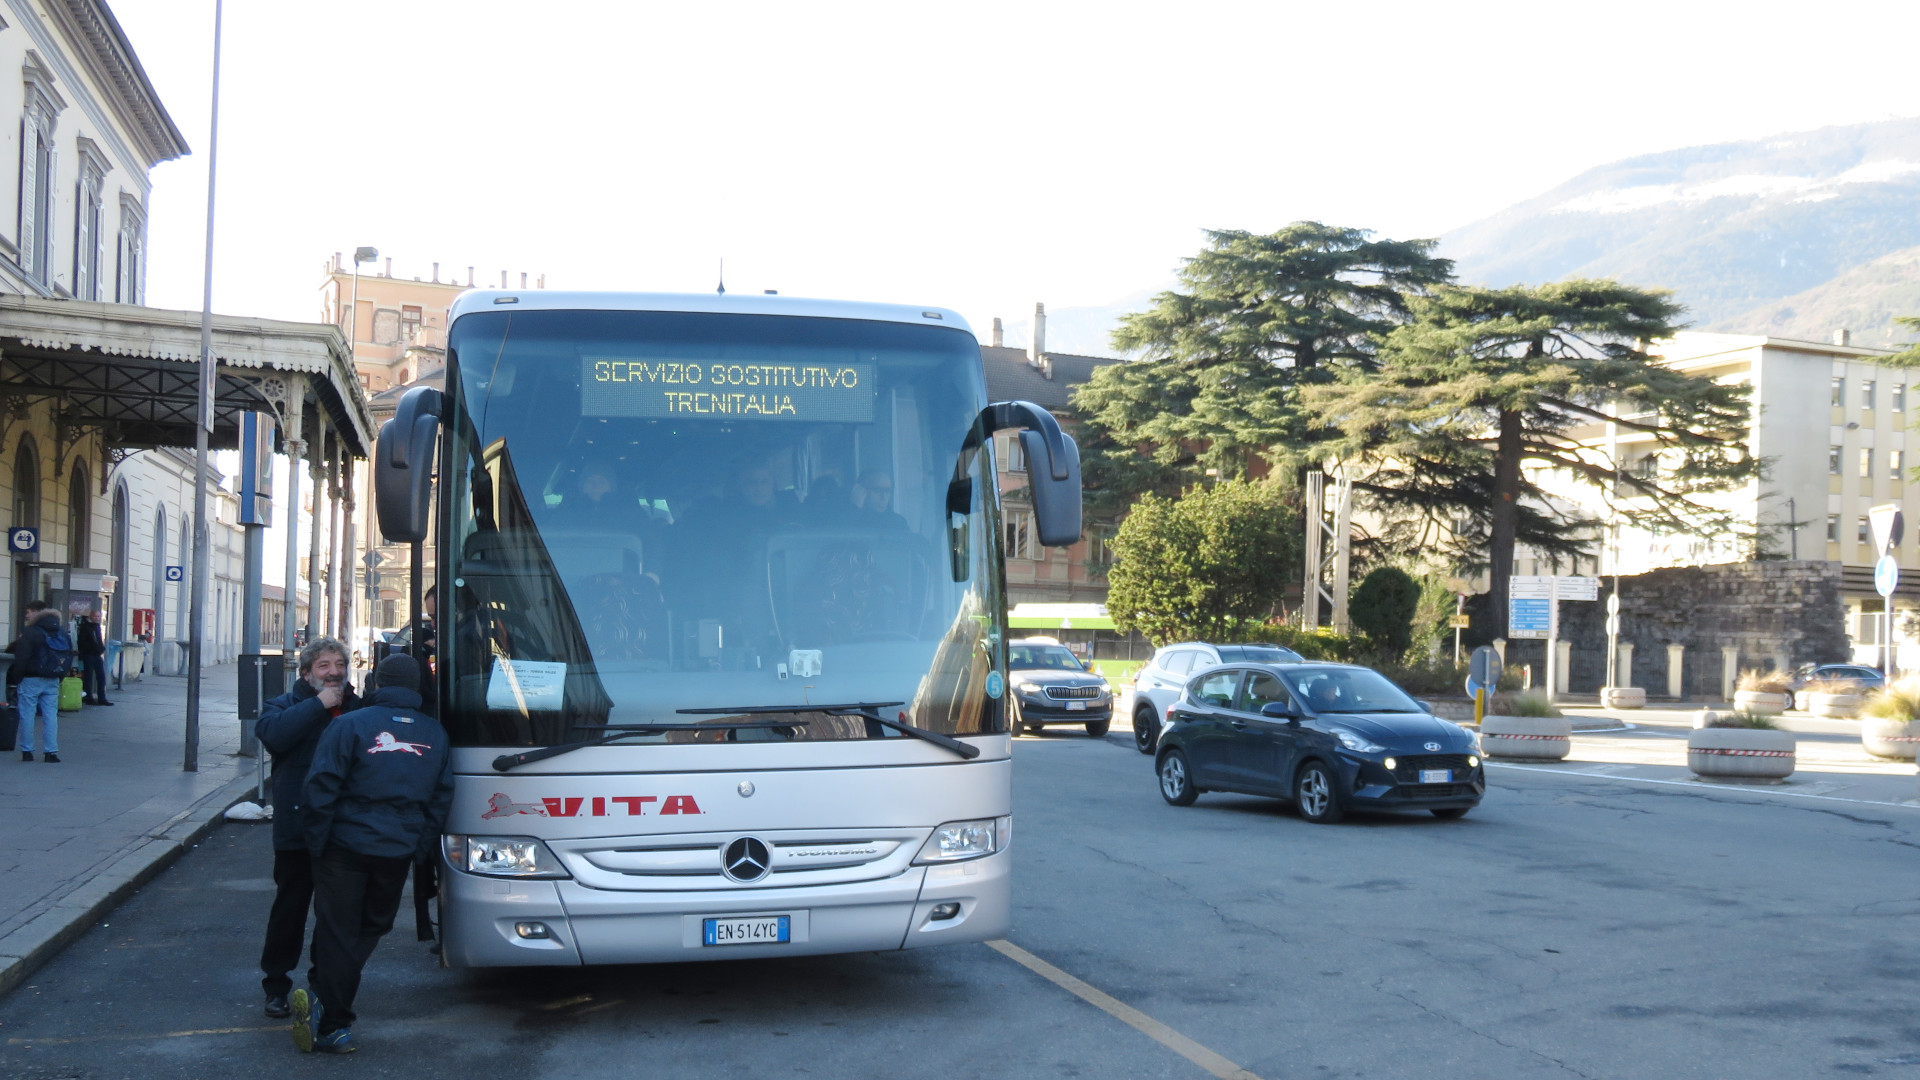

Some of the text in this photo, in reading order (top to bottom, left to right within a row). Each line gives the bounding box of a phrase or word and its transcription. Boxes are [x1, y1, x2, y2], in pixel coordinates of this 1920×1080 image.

[595, 361, 858, 388] SERVIZIO SOSTITUTIVO
[664, 392, 796, 415] TRENITALIA
[991, 680, 1000, 695] 5
[787, 848, 877, 858] TOURISMO
